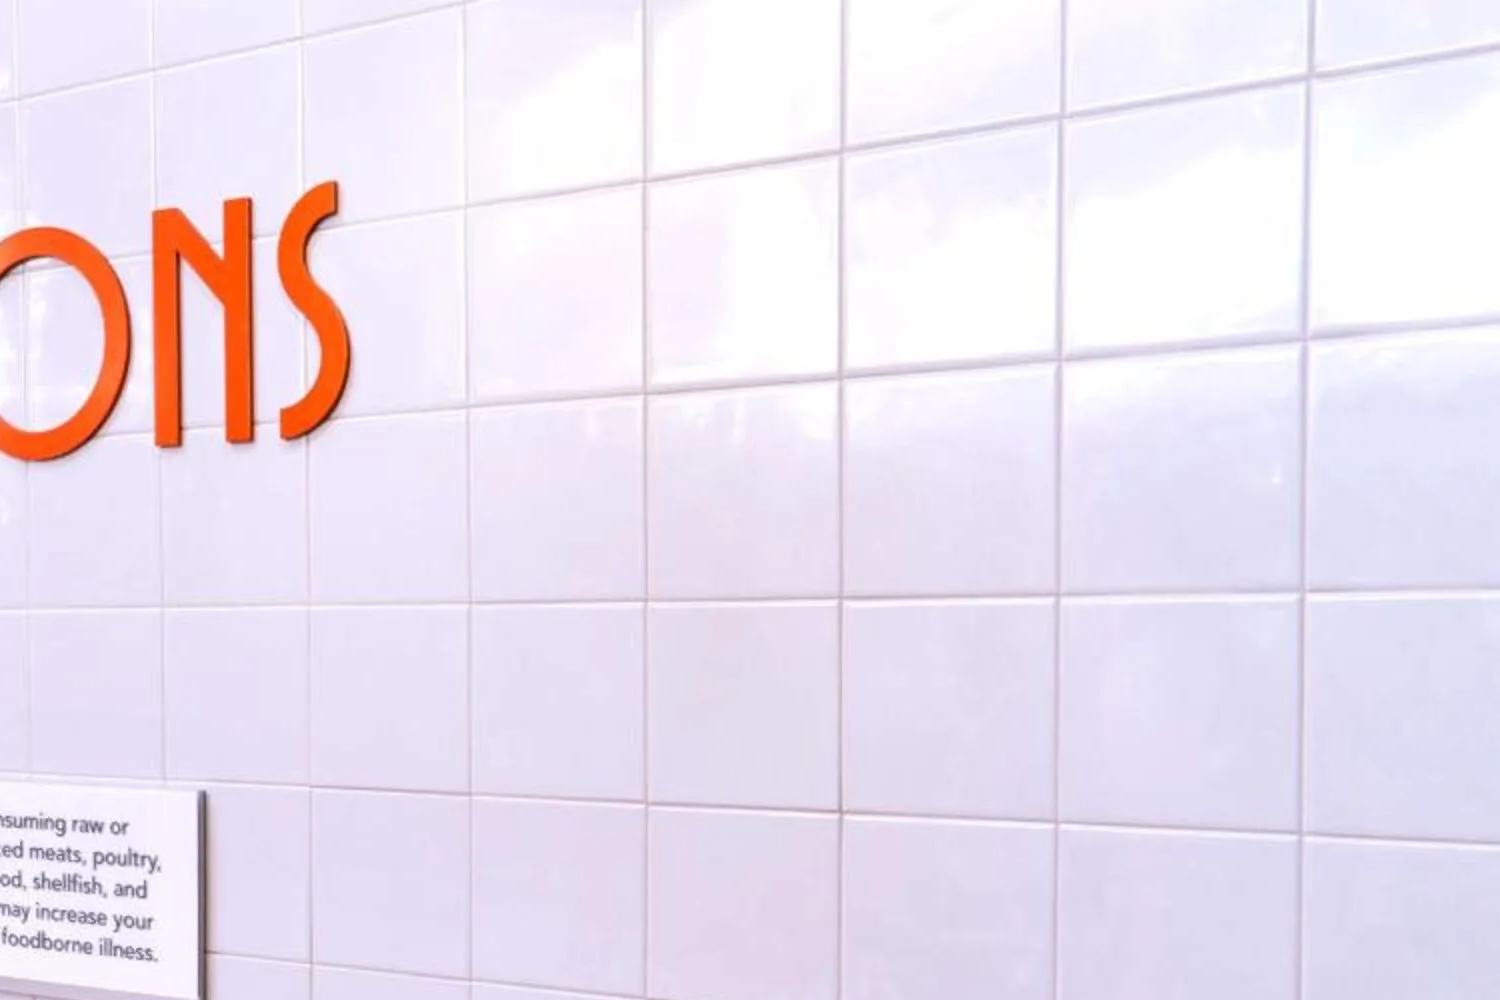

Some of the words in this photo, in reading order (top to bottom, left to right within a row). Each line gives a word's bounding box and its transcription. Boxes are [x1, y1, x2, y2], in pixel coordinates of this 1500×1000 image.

[71, 818, 105, 835] raw
[109, 820, 130, 836] or
[28, 846, 88, 867] meats,
[91, 847, 162, 873] poultry,
[32, 870, 108, 899] shellfish,
[112, 879, 149, 900] and
[35, 901, 108, 927] increase
[112, 913, 155, 934] your
[0, 926, 95, 956] foodborne
[98, 937, 159, 963] illness.
